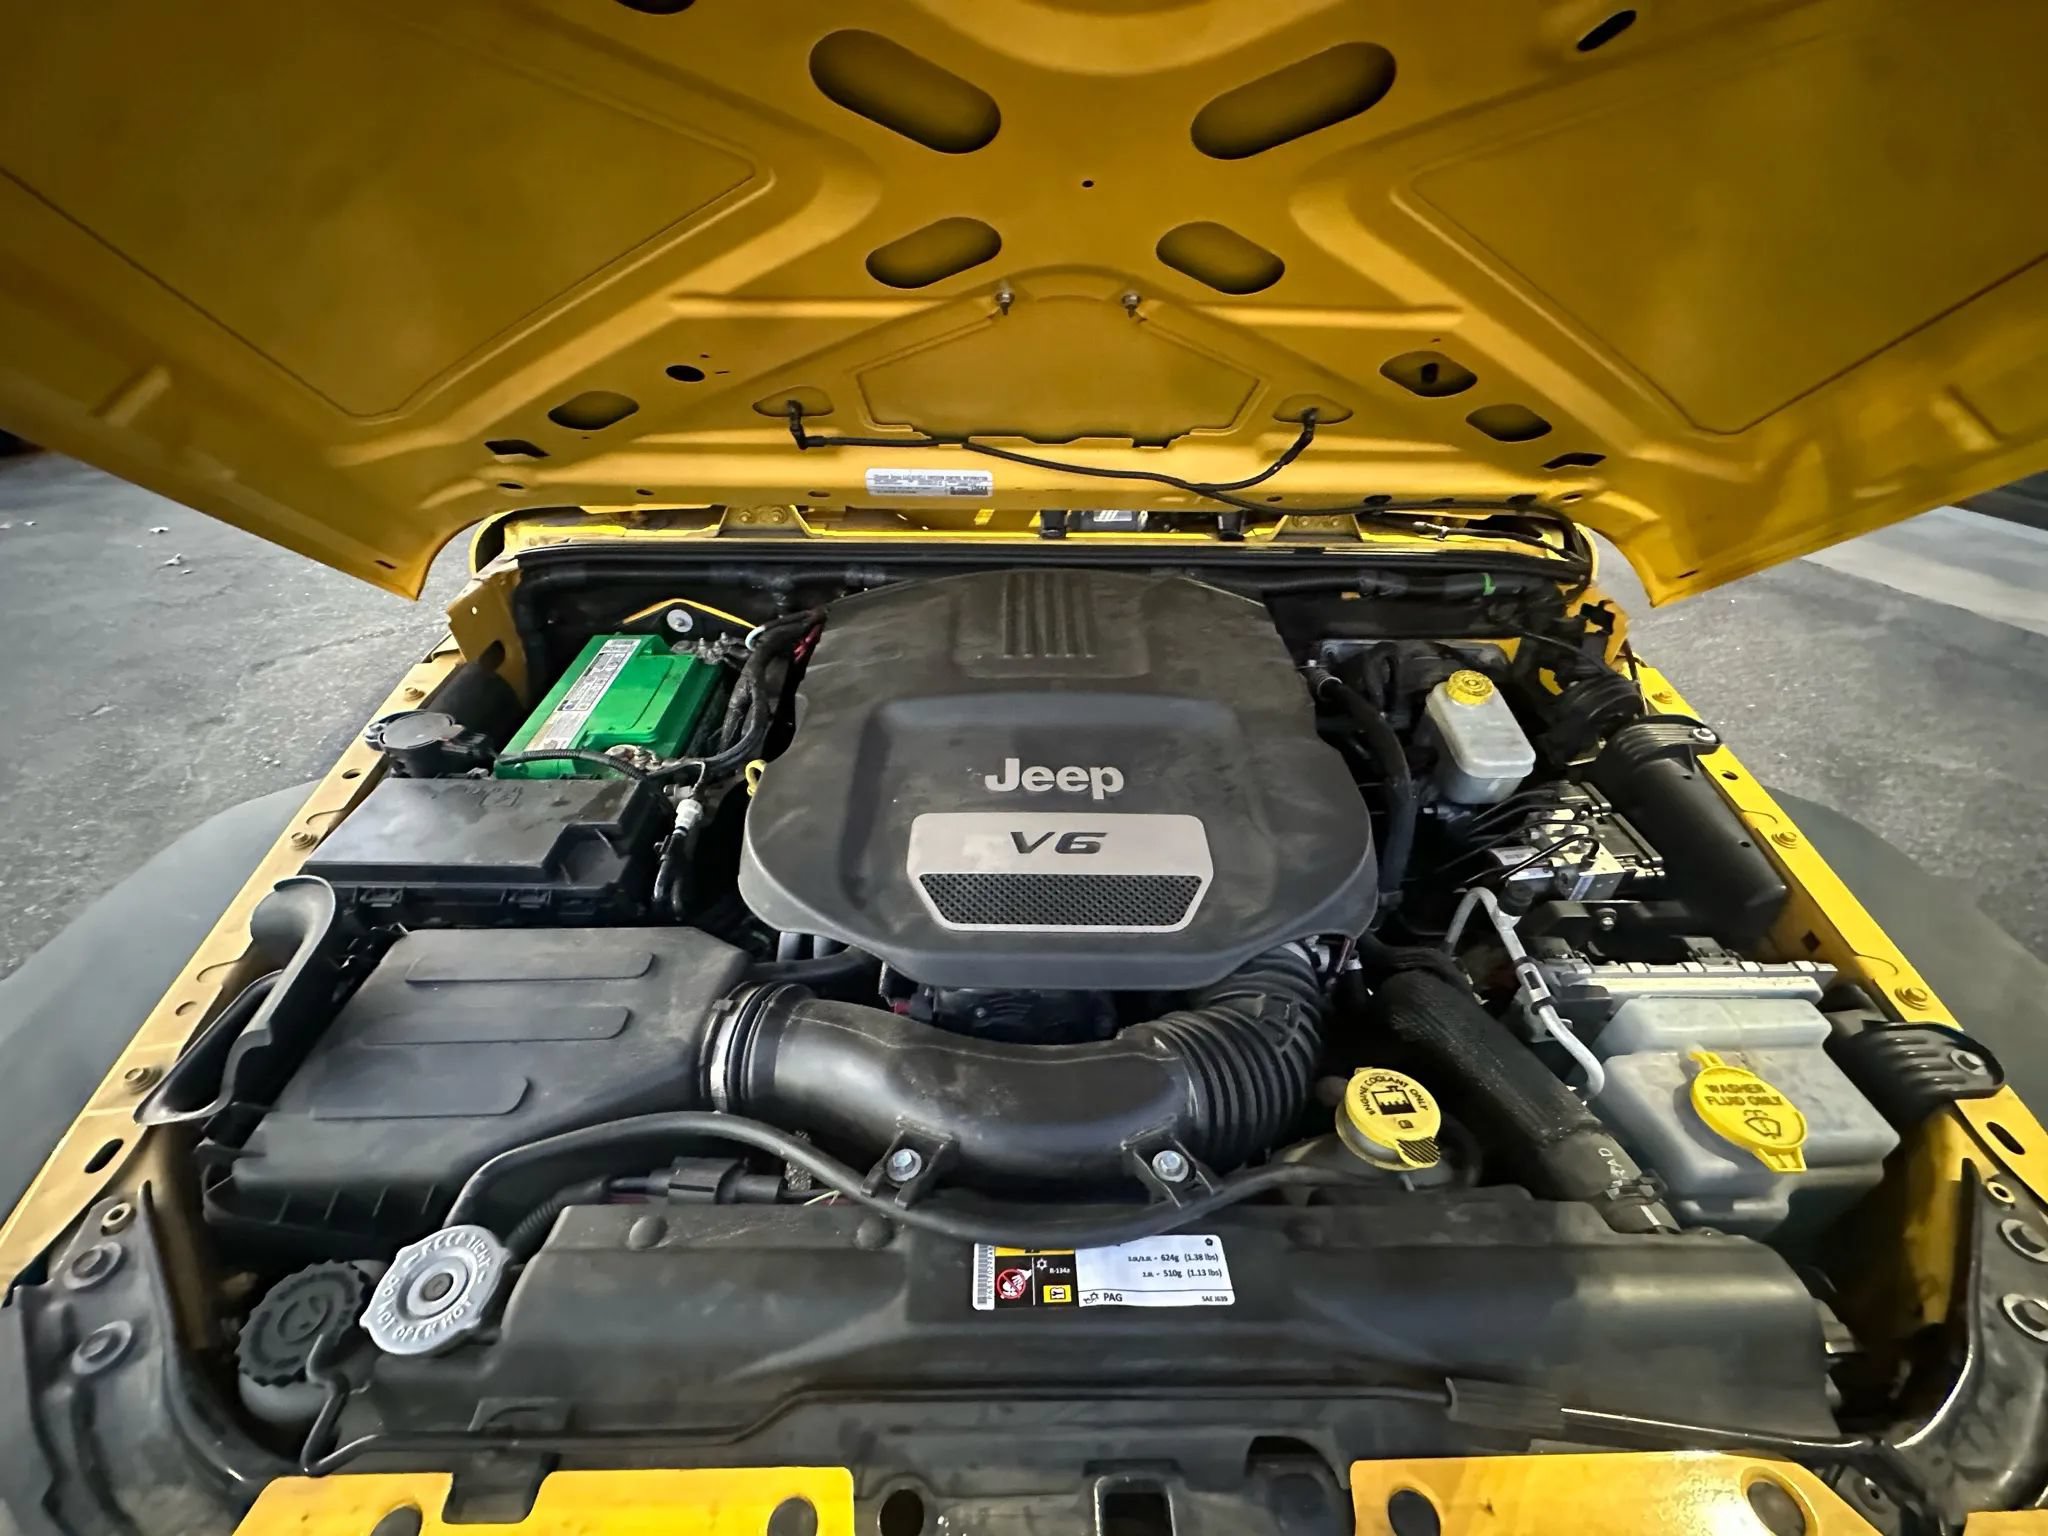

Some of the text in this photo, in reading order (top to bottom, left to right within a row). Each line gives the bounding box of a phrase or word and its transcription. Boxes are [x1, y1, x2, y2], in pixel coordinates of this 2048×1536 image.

[985, 757, 1124, 800] Jeep
[1010, 831, 1108, 855] V6
[1364, 1075, 1409, 1088] COOLANT
[1409, 1088, 1429, 1111] ONLY
[1704, 1084, 1766, 1093] WASHER
[1704, 1096, 1784, 1106] FLUID ONLY
[421, 1231, 493, 1269] KEEP TIGHT
[1160, 1254, 1180, 1262] 624g
[1184, 1253, 1204, 1262] (1.38
[1204, 1253, 1219, 1262] lbs)
[1163, 1269, 1182, 1278] 510g
[1187, 1269, 1206, 1278] (1.13
[1207, 1269, 1222, 1278] lbs)
[1103, 1293, 1123, 1303] PAG
[391, 1322, 437, 1342] OPEN
